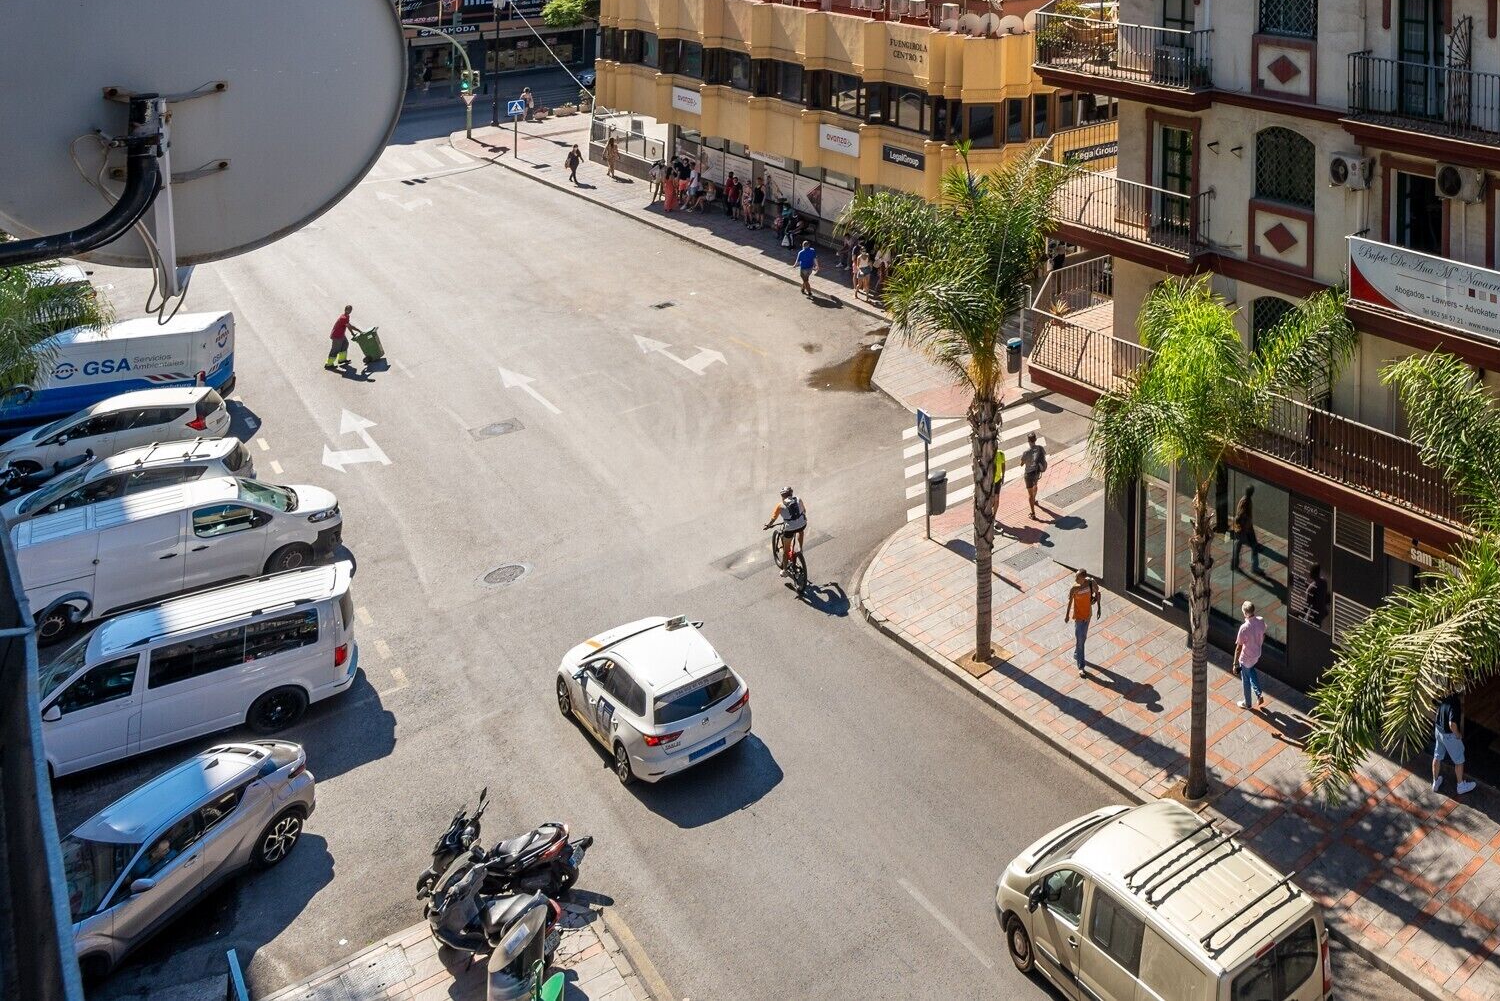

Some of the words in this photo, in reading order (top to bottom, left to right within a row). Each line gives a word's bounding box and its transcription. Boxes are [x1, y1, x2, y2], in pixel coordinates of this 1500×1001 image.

[889, 38, 928, 52] FUENGIROLA
[892, 50, 917, 61] CENTRO
[919, 55, 923, 63] 2
[889, 150, 919, 167] LegalGroup
[1358, 244, 1388, 264] Bufete
[1390, 251, 1407, 267] De
[1409, 258, 1434, 275] Ana
[1394, 285, 1425, 300] Abogados
[1431, 294, 1458, 310] Lawyers
[1464, 303, 1499, 320] Advokater
[1430, 309, 1440, 318] 952
[1457, 317, 1464, 325] 21
[83, 357, 131, 376] GSA
[133, 354, 172, 363] Servicios
[133, 359, 185, 370] Ambientales
